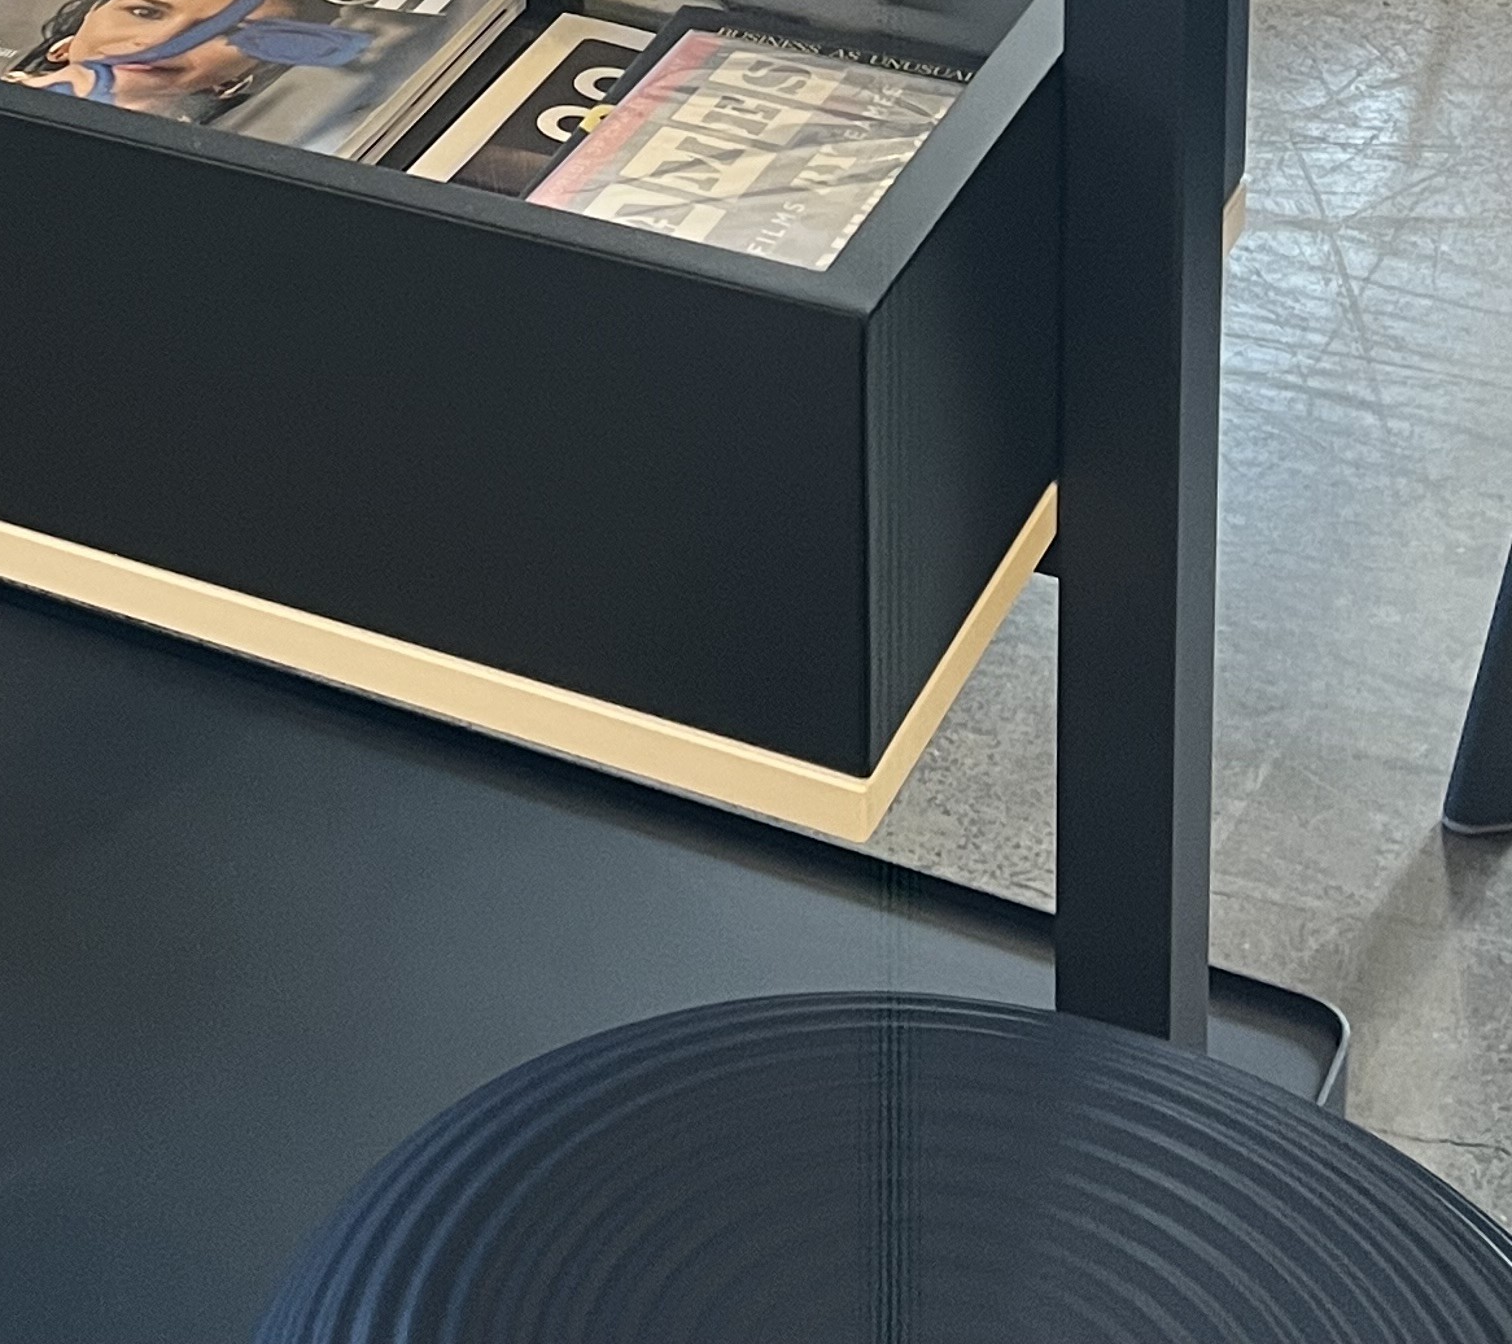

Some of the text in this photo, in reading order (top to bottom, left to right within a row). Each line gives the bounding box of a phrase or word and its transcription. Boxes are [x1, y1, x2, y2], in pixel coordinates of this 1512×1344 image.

[717, 27, 822, 55] BUSINESS
[829, 48, 861, 62] AS
[746, 202, 806, 257] FILMS
